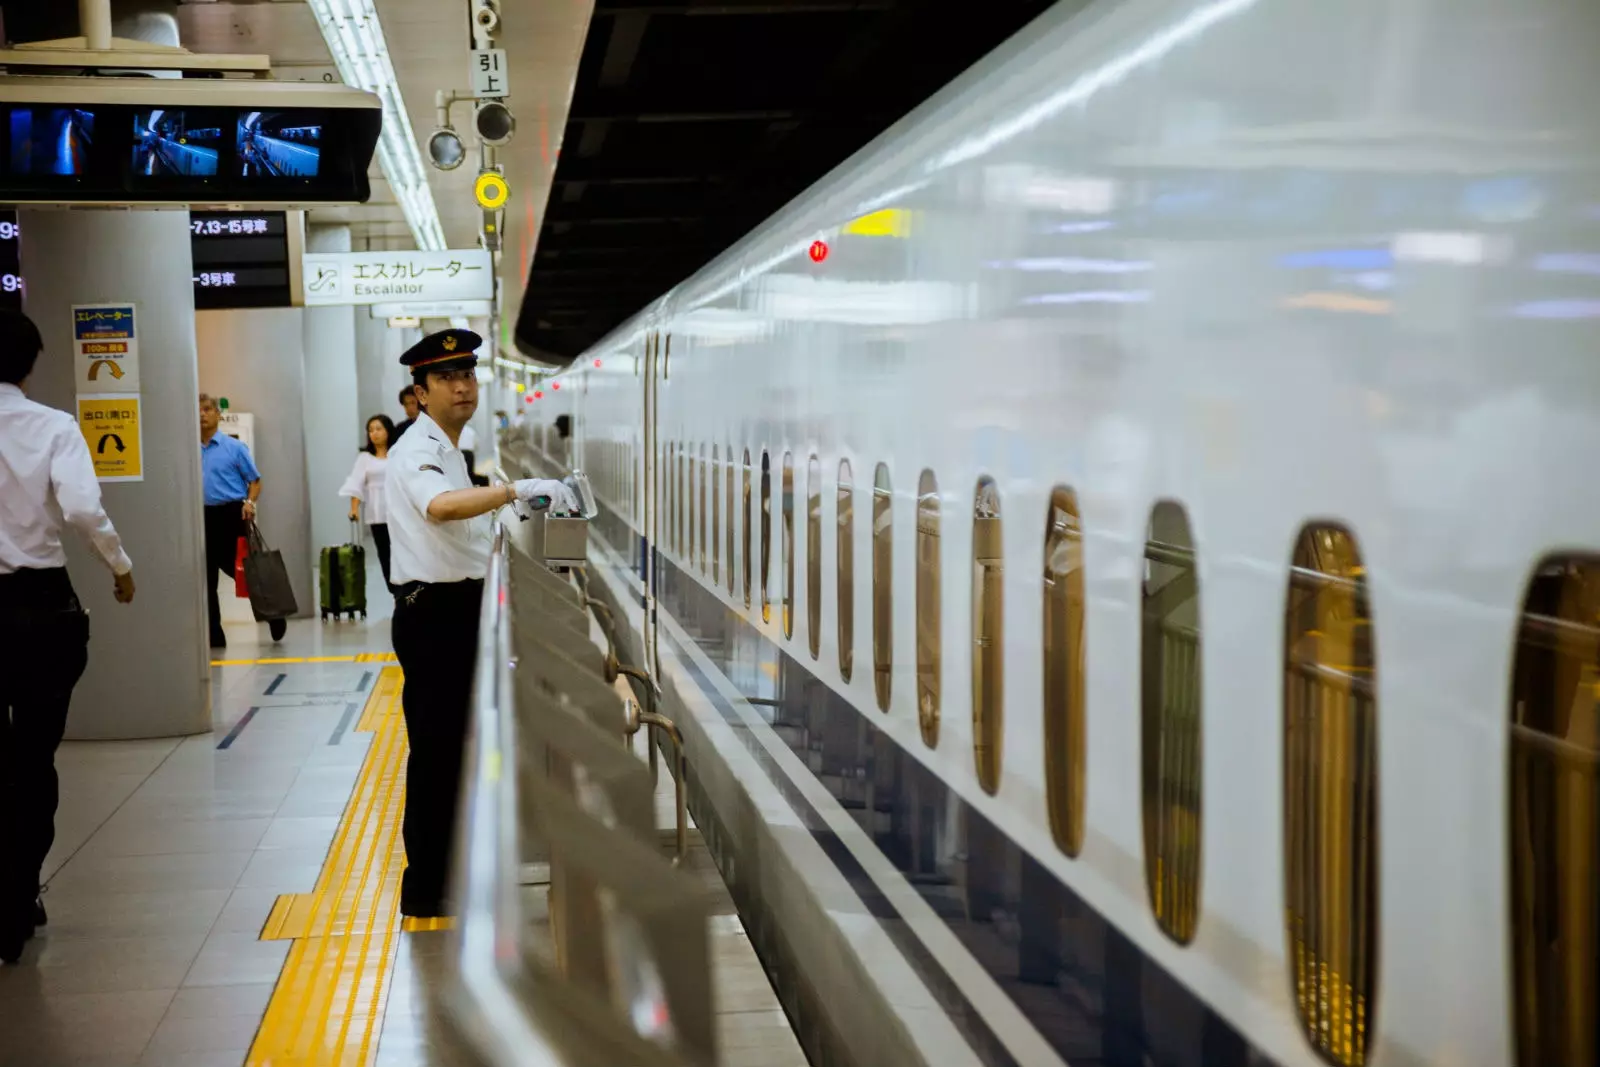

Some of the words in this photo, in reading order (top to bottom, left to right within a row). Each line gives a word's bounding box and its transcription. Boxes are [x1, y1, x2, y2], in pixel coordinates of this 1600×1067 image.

[480, 53, 501, 92] 引上
[353, 261, 482, 278] エスカレーター
[354, 284, 423, 295] Escalator
